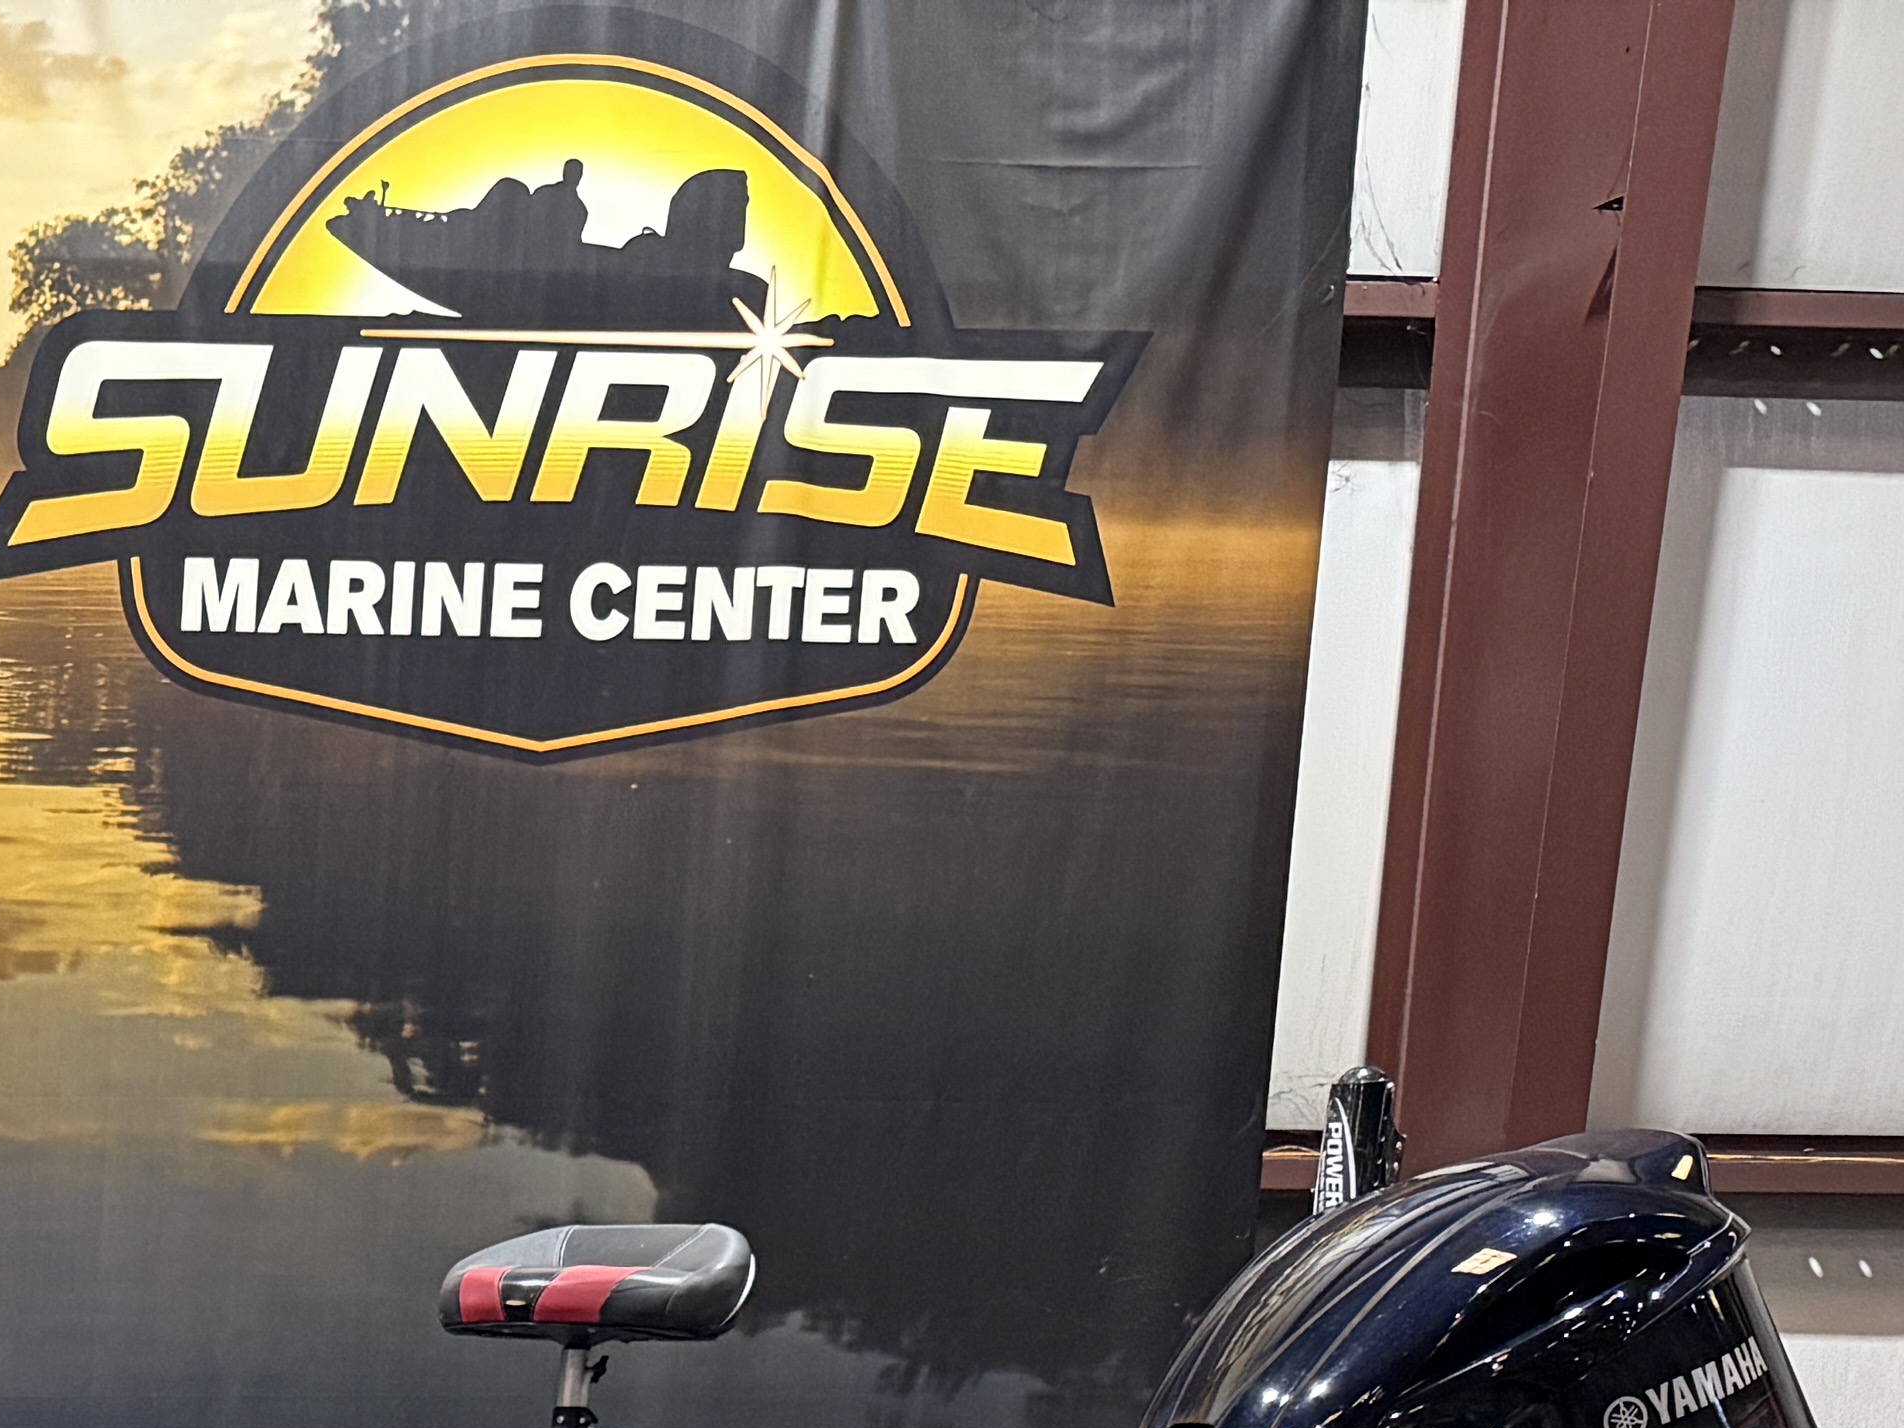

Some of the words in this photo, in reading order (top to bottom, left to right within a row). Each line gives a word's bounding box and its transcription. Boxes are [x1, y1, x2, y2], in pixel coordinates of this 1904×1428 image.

[7, 339, 1104, 566] SUNRISE
[179, 557, 544, 640] MARINE
[569, 562, 921, 645] CENTER
[1325, 1122, 1343, 1208] POWER
[1645, 1336, 1768, 1425] YAMAHA
